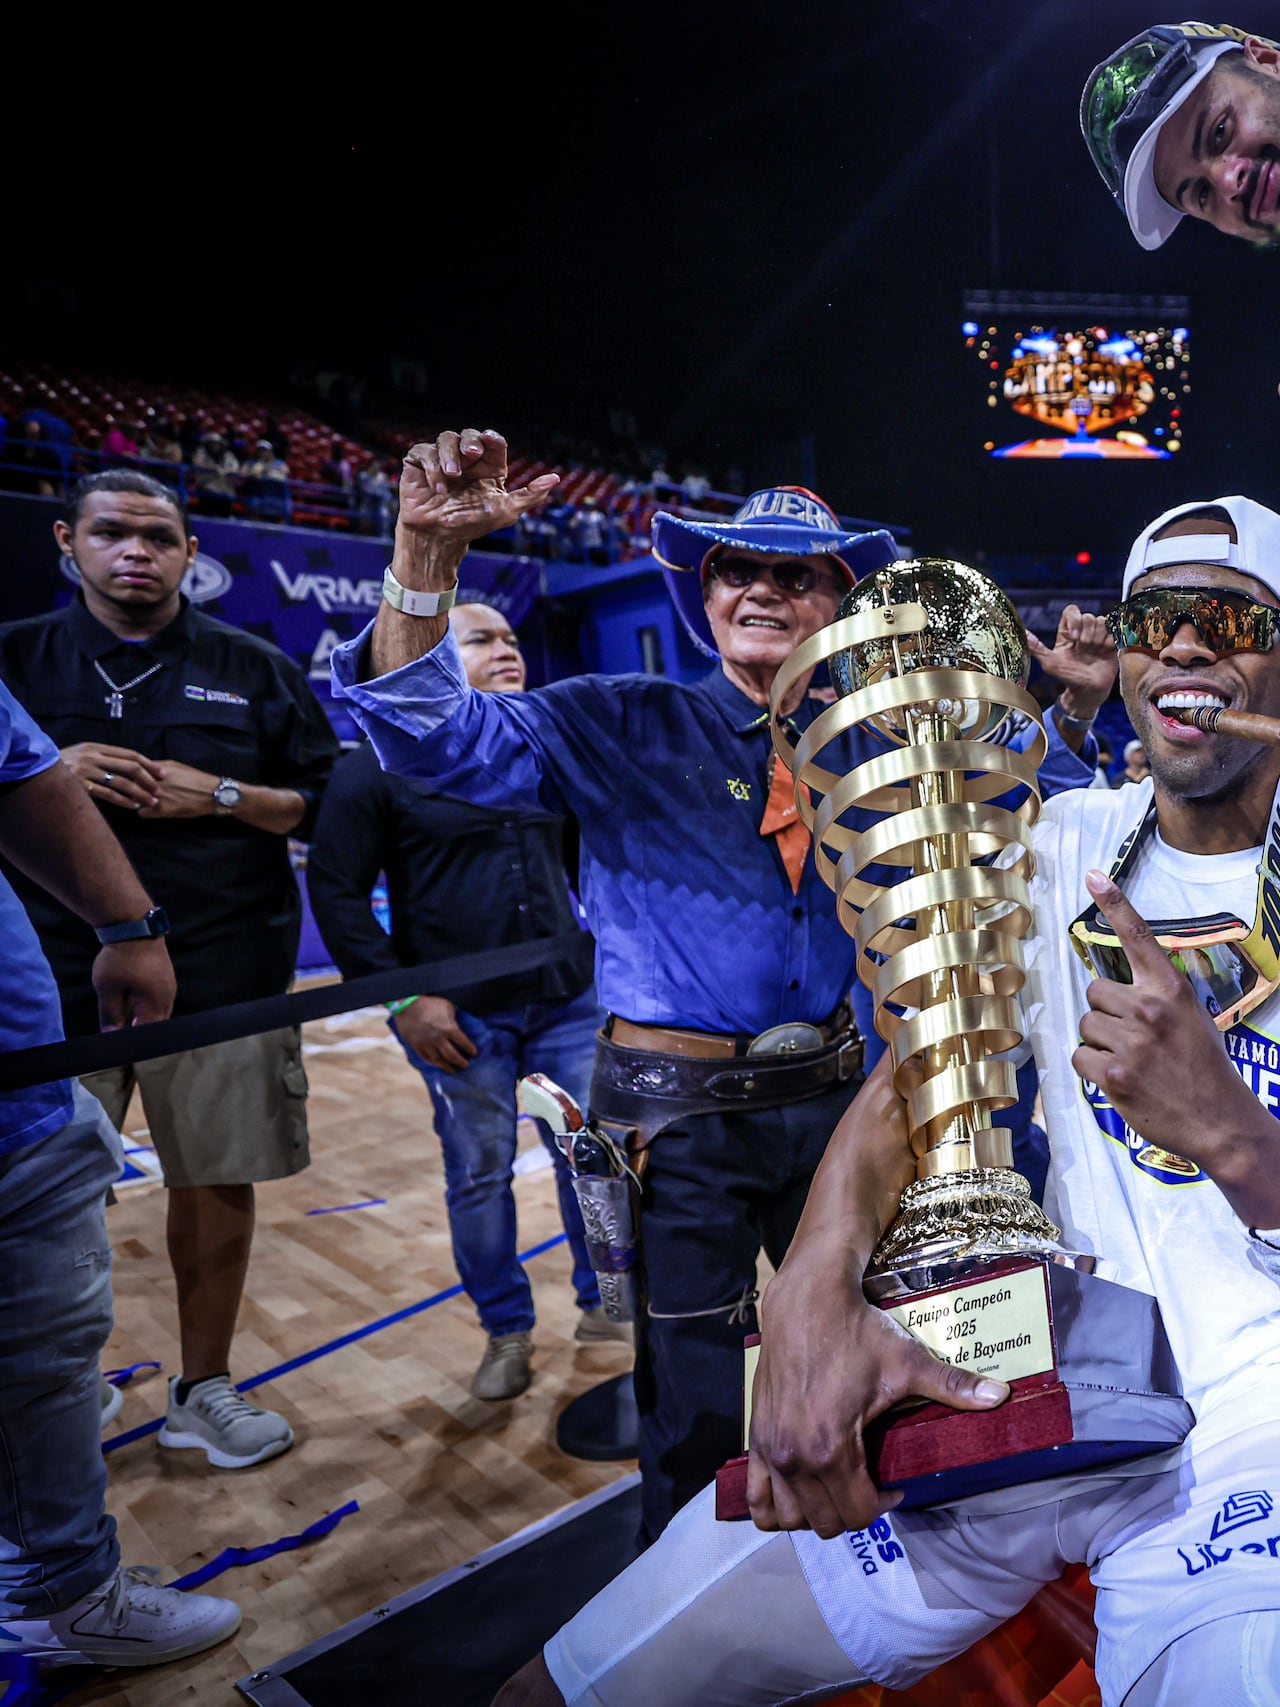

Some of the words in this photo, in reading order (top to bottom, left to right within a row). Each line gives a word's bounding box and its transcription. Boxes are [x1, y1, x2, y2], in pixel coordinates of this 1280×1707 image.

[908, 1305, 950, 1328] Equipo
[954, 1288, 1012, 1314] Campeón
[946, 1318, 977, 1341] 2025
[955, 1346, 970, 1365] de
[973, 1333, 1032, 1360] Bayamón
